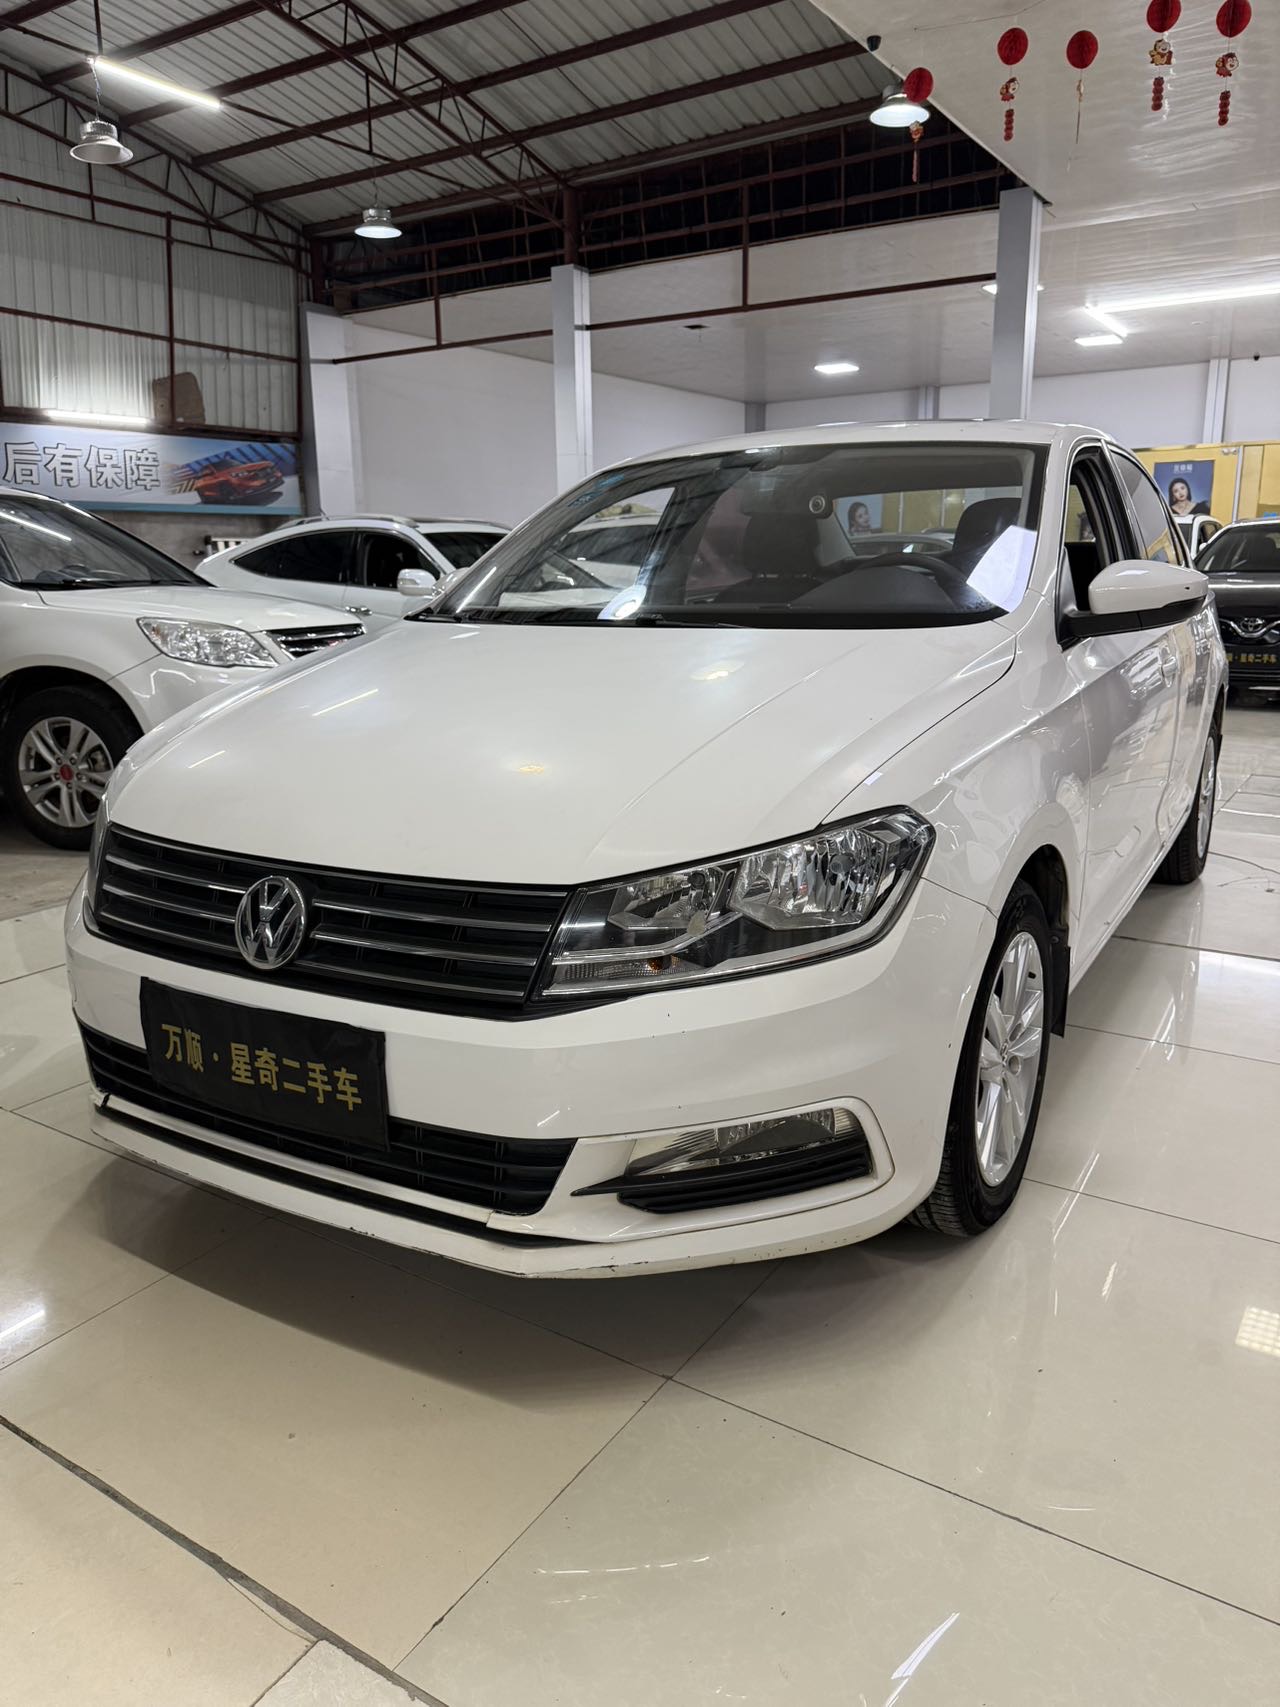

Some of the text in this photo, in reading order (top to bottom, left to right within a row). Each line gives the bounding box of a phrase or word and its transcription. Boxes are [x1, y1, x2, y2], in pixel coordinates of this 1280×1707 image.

[4, 442, 160, 490] 后有保障
[161, 1023, 363, 1112] 万顺·星奇二手车
